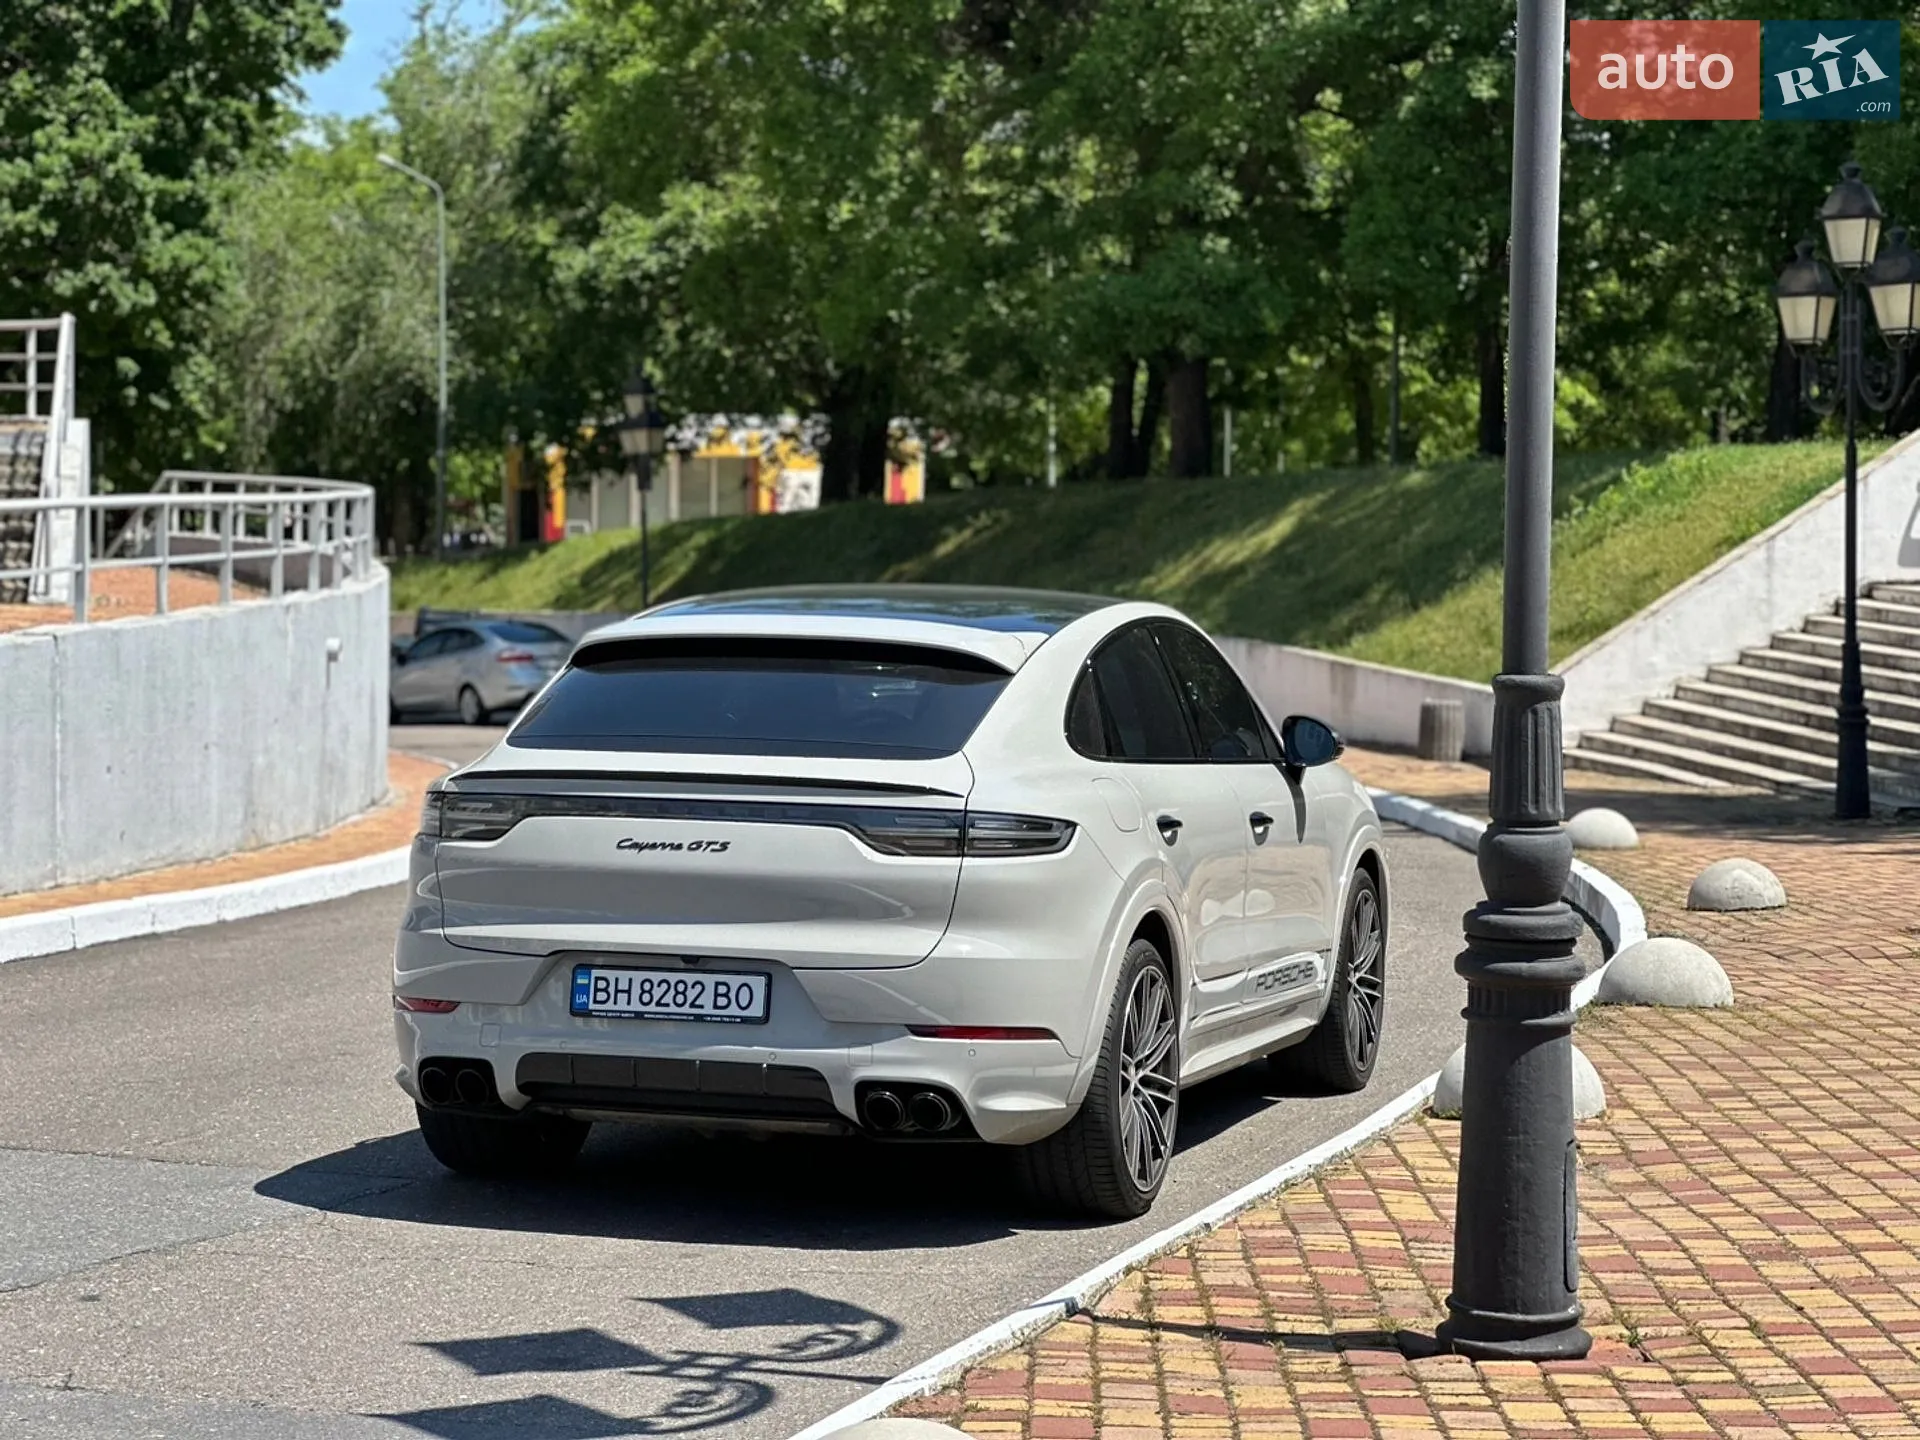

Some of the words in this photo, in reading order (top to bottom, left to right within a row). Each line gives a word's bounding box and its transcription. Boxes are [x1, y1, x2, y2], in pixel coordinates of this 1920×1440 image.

[616, 838, 684, 854] Cayenne
[687, 840, 731, 852] GTS
[1255, 961, 1314, 993] PORSCHE
[576, 993, 588, 1004] UA
[592, 976, 633, 1006] BH
[638, 978, 705, 1010] 8282
[712, 981, 754, 1011] BO
